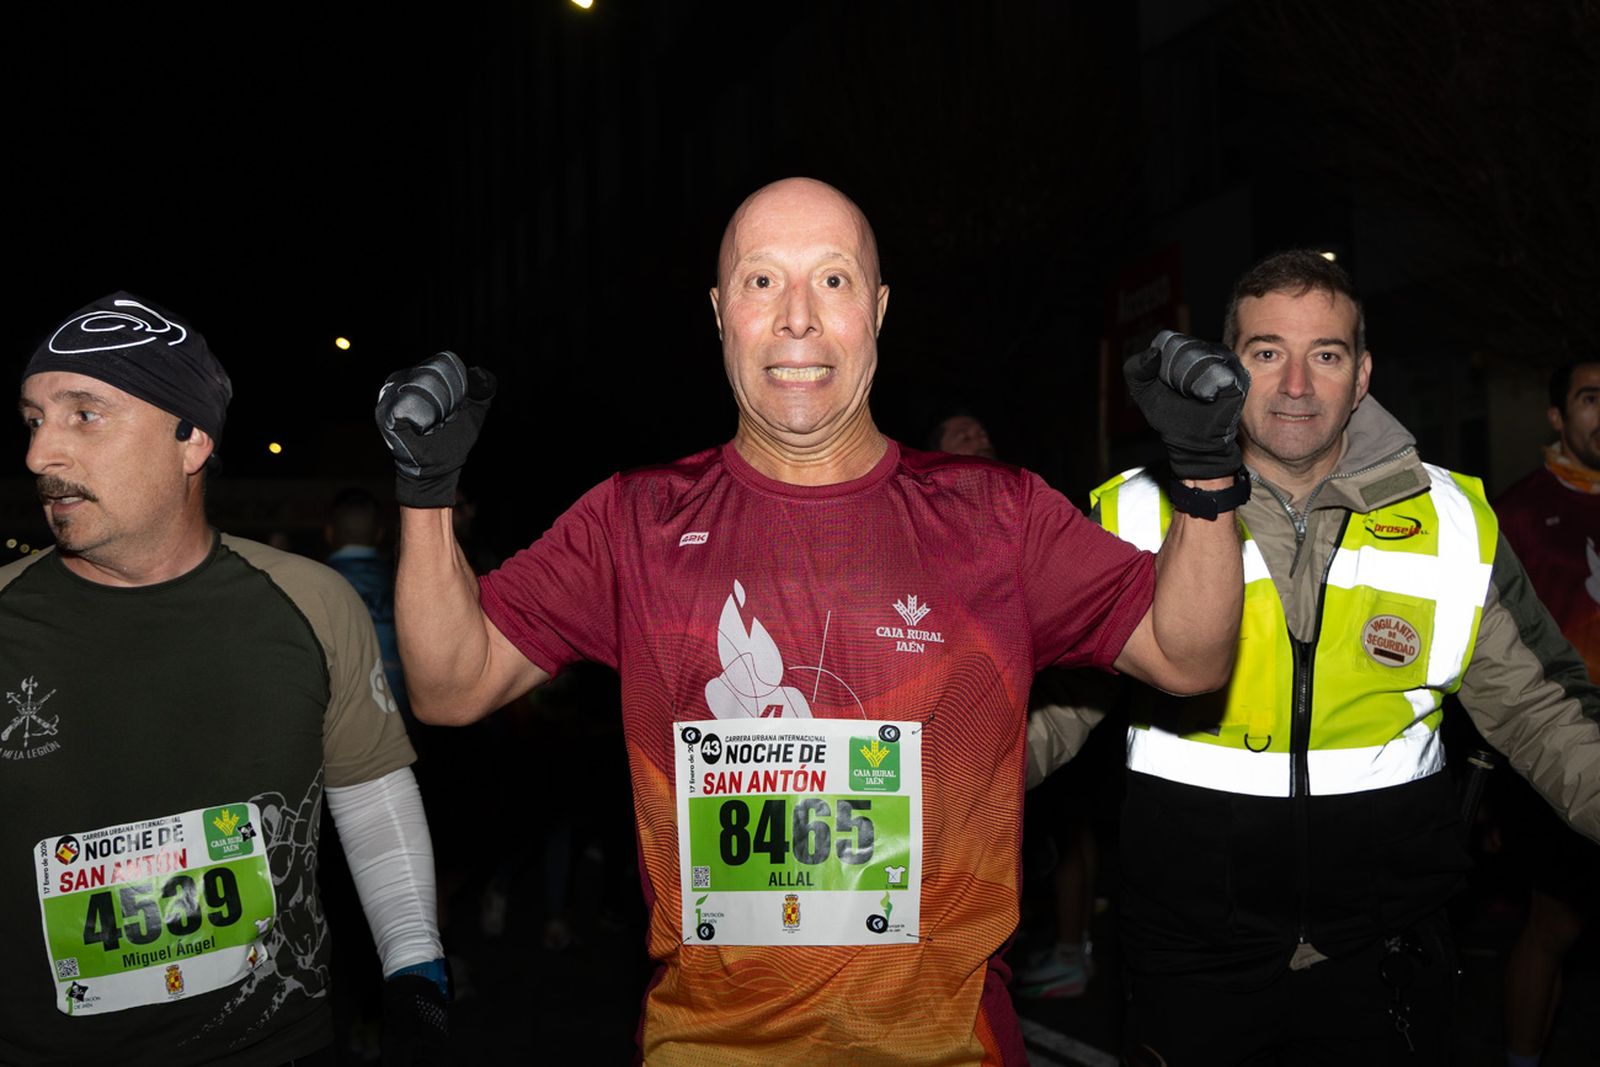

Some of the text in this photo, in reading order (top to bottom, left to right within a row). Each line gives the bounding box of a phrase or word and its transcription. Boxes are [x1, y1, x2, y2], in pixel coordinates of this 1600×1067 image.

[876, 626, 944, 643] CAJA RURAL
[1371, 618, 1416, 642] VIGILANTE
[1388, 631, 1397, 639] DE
[896, 641, 925, 653] JAÉN
[1367, 633, 1415, 656] SEGURIDAD
[702, 741, 720, 756] 43
[725, 743, 827, 764] NOCHE DE
[688, 754, 694, 763] de
[703, 764, 826, 794] SAN ANTÓN
[853, 769, 896, 778] CAJA RURAL
[690, 785, 696, 793] 17
[82, 831, 108, 842] CARRERA
[109, 826, 134, 836] URBANA
[719, 798, 874, 866] 8465
[85, 831, 152, 861] NOCHE
[158, 824, 185, 846] DE
[42, 858, 48, 866] de
[59, 865, 105, 893] SAN
[111, 848, 188, 884] ANTÓN
[769, 872, 814, 887] ALLAL
[83, 867, 242, 952] 4539
[123, 936, 216, 967] Miguel Ángel
